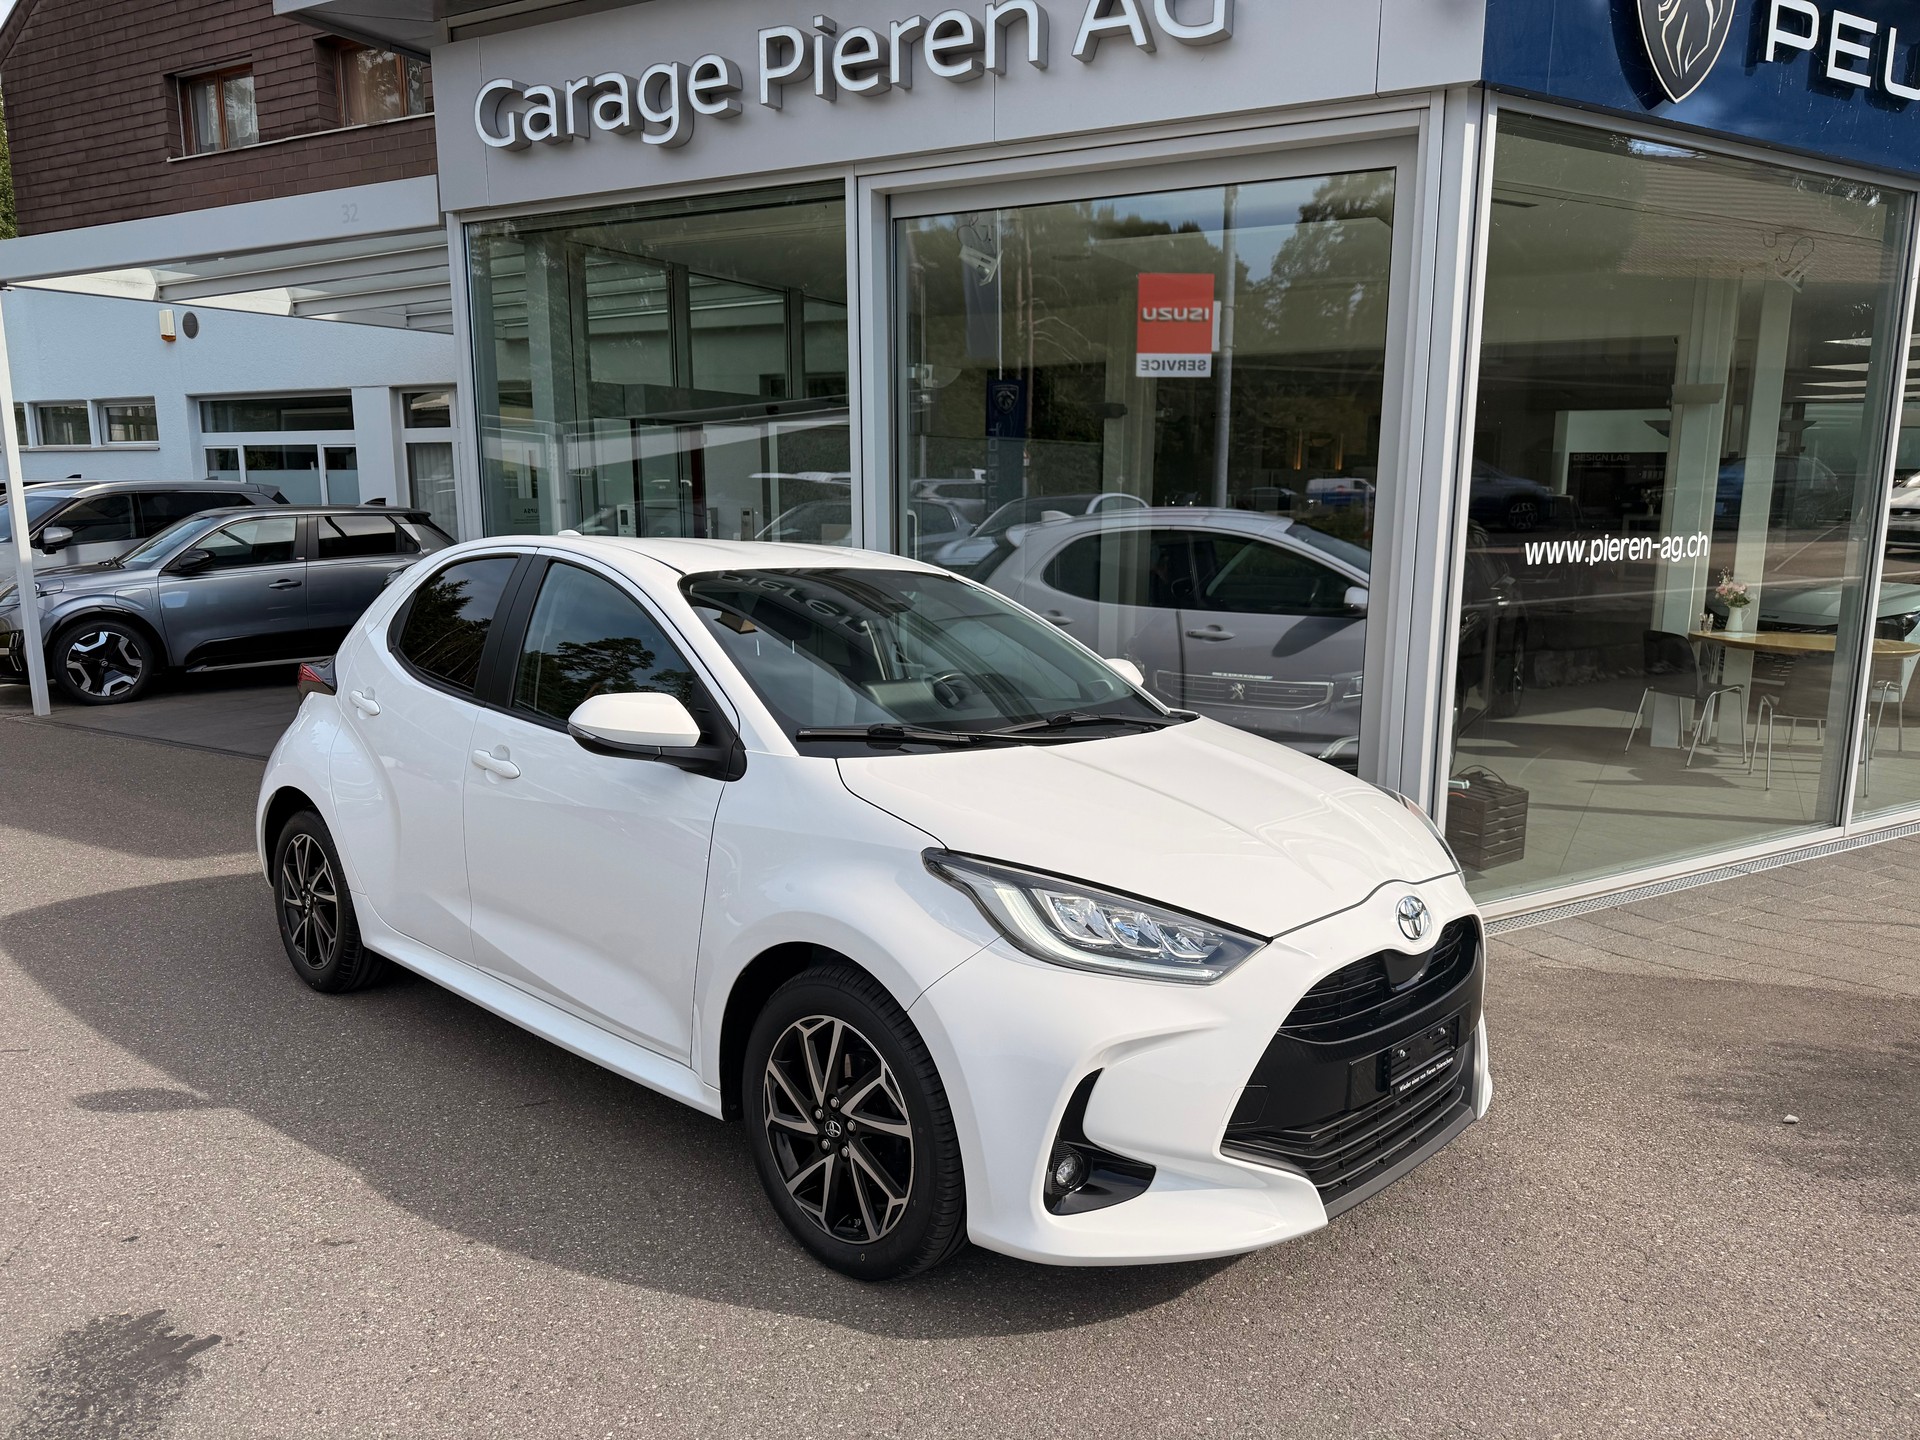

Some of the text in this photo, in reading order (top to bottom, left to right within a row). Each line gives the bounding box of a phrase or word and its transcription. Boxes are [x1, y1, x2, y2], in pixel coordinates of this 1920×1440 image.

[1763, 0, 1920, 100] PEU
[473, 52, 743, 149] Garage
[757, 0, 1050, 110] Pieren
[341, 202, 360, 225] 32
[1573, 453, 1631, 463] DESIGN LAB
[1525, 531, 1709, 566] www.pieren-ag.ch
